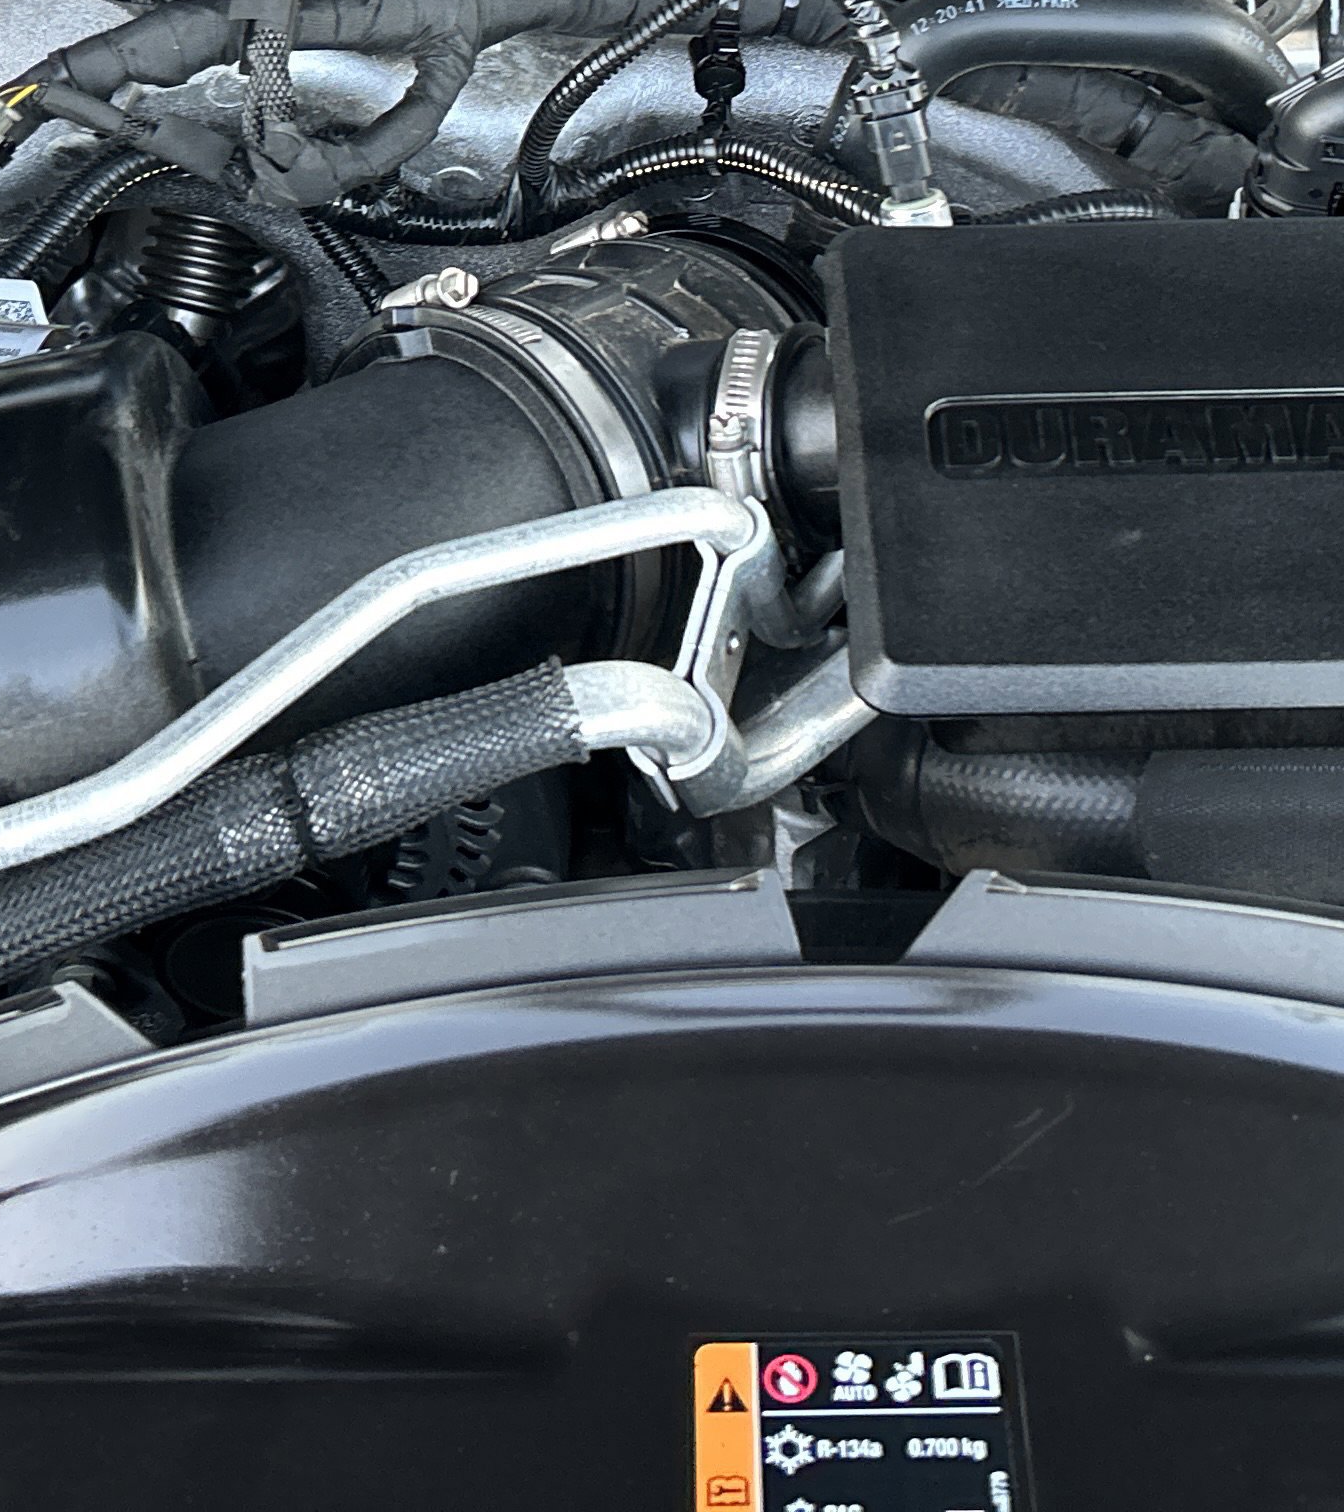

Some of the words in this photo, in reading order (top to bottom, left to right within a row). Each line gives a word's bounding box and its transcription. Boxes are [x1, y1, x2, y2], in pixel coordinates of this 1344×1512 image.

[832, 1384, 878, 1402] AUTO
[816, 1437, 885, 1459] R-134a
[906, 1437, 959, 1459] 0.700
[960, 1437, 988, 1461] kg
